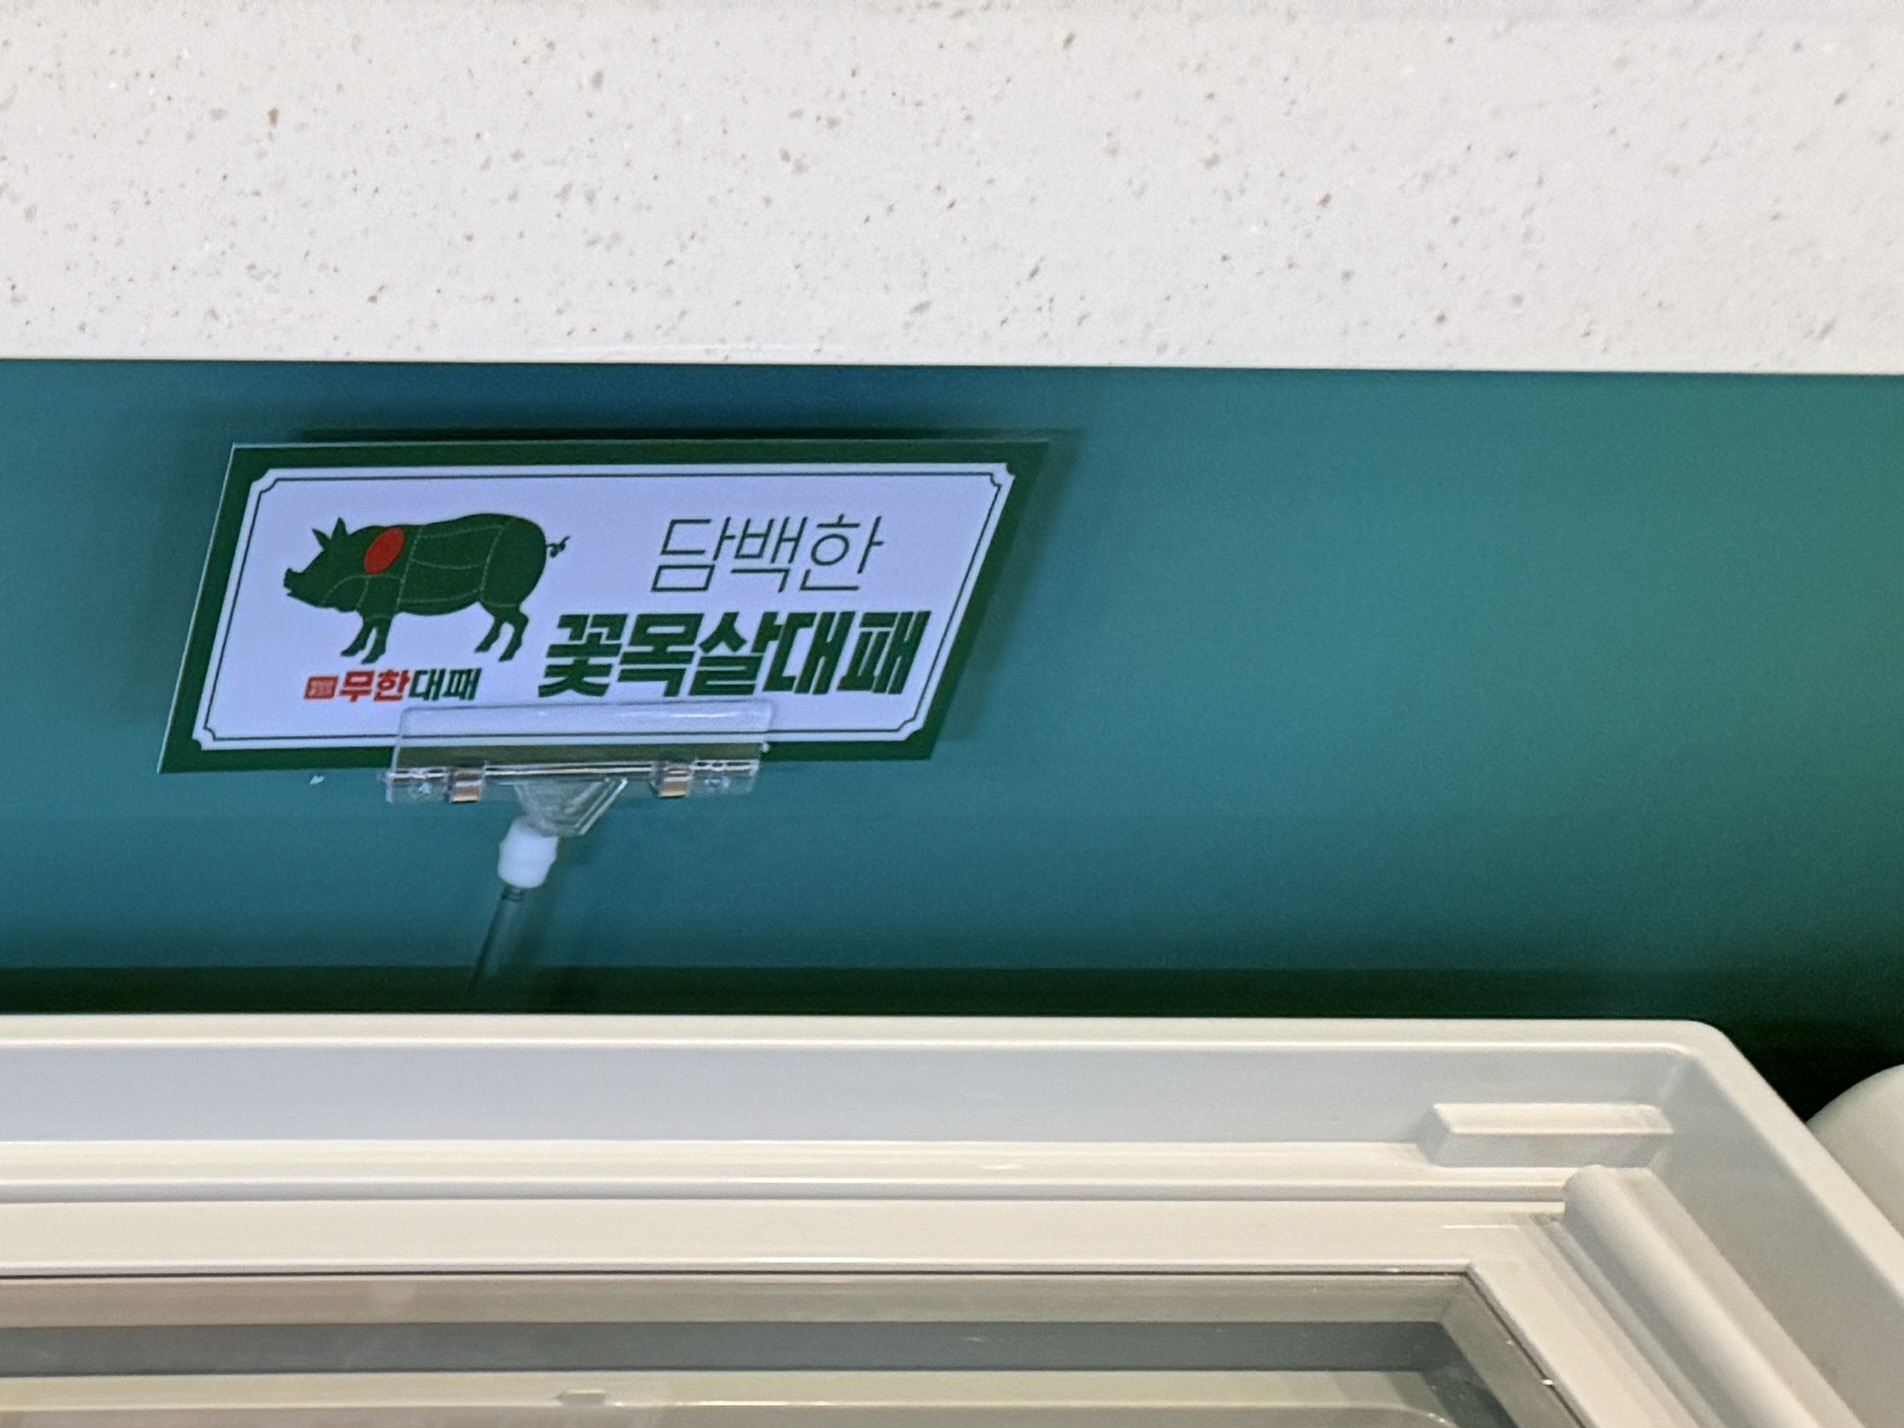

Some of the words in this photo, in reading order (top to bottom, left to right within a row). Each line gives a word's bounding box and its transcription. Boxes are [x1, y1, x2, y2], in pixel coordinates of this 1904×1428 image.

[650, 512, 885, 594] 담백한
[339, 667, 483, 702] 무한대패
[537, 609, 932, 699] 꽃목살대패
